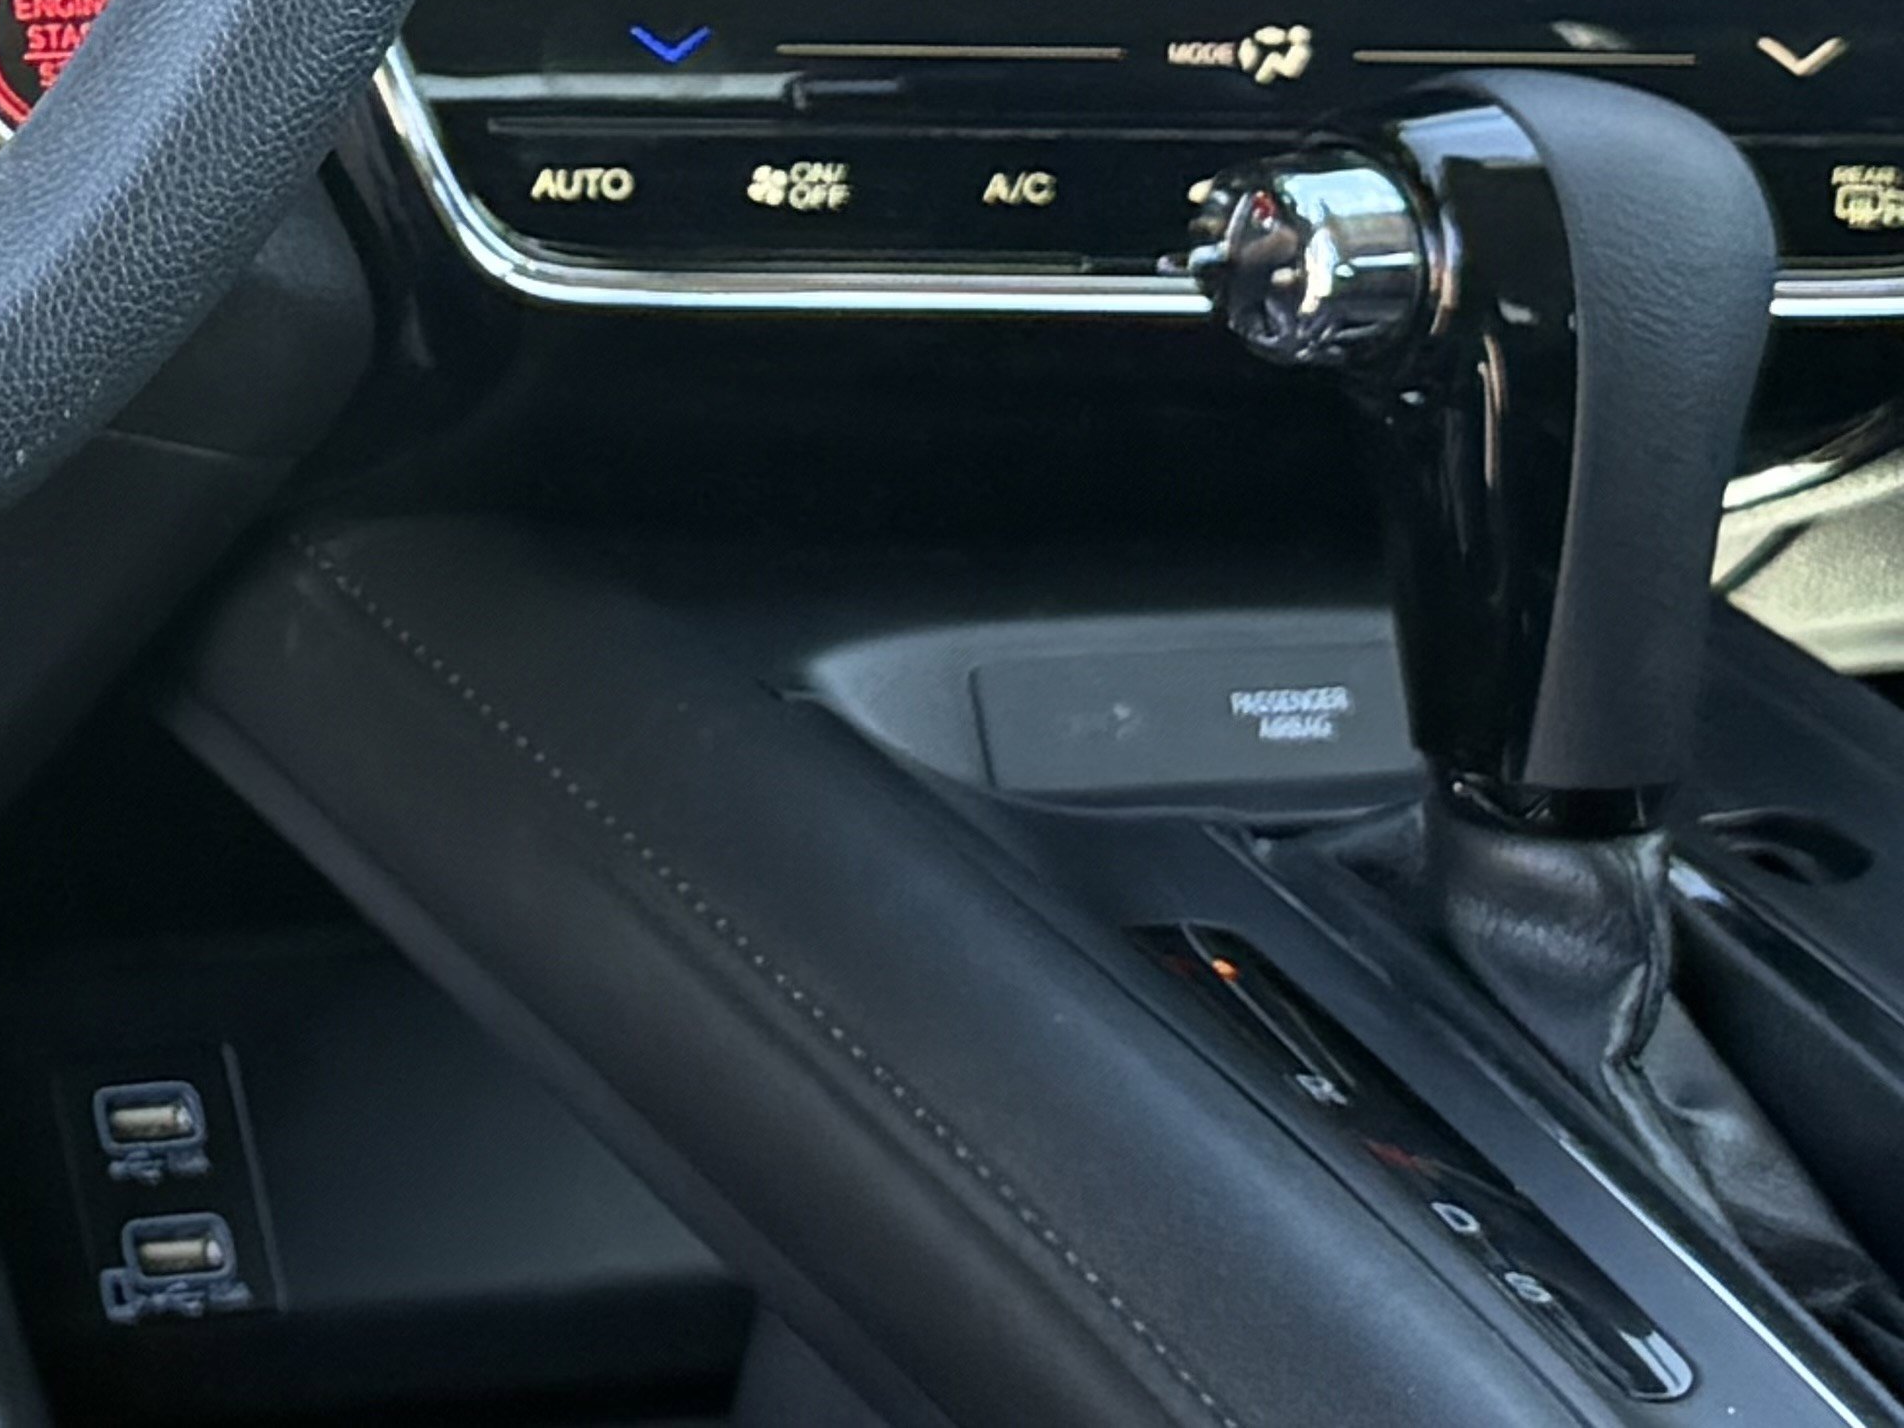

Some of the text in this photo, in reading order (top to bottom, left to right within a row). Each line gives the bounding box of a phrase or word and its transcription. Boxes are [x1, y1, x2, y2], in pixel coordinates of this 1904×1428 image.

[1168, 41, 1235, 66] MODE
[530, 167, 635, 202] AUTO
[982, 171, 1058, 206] A/C
